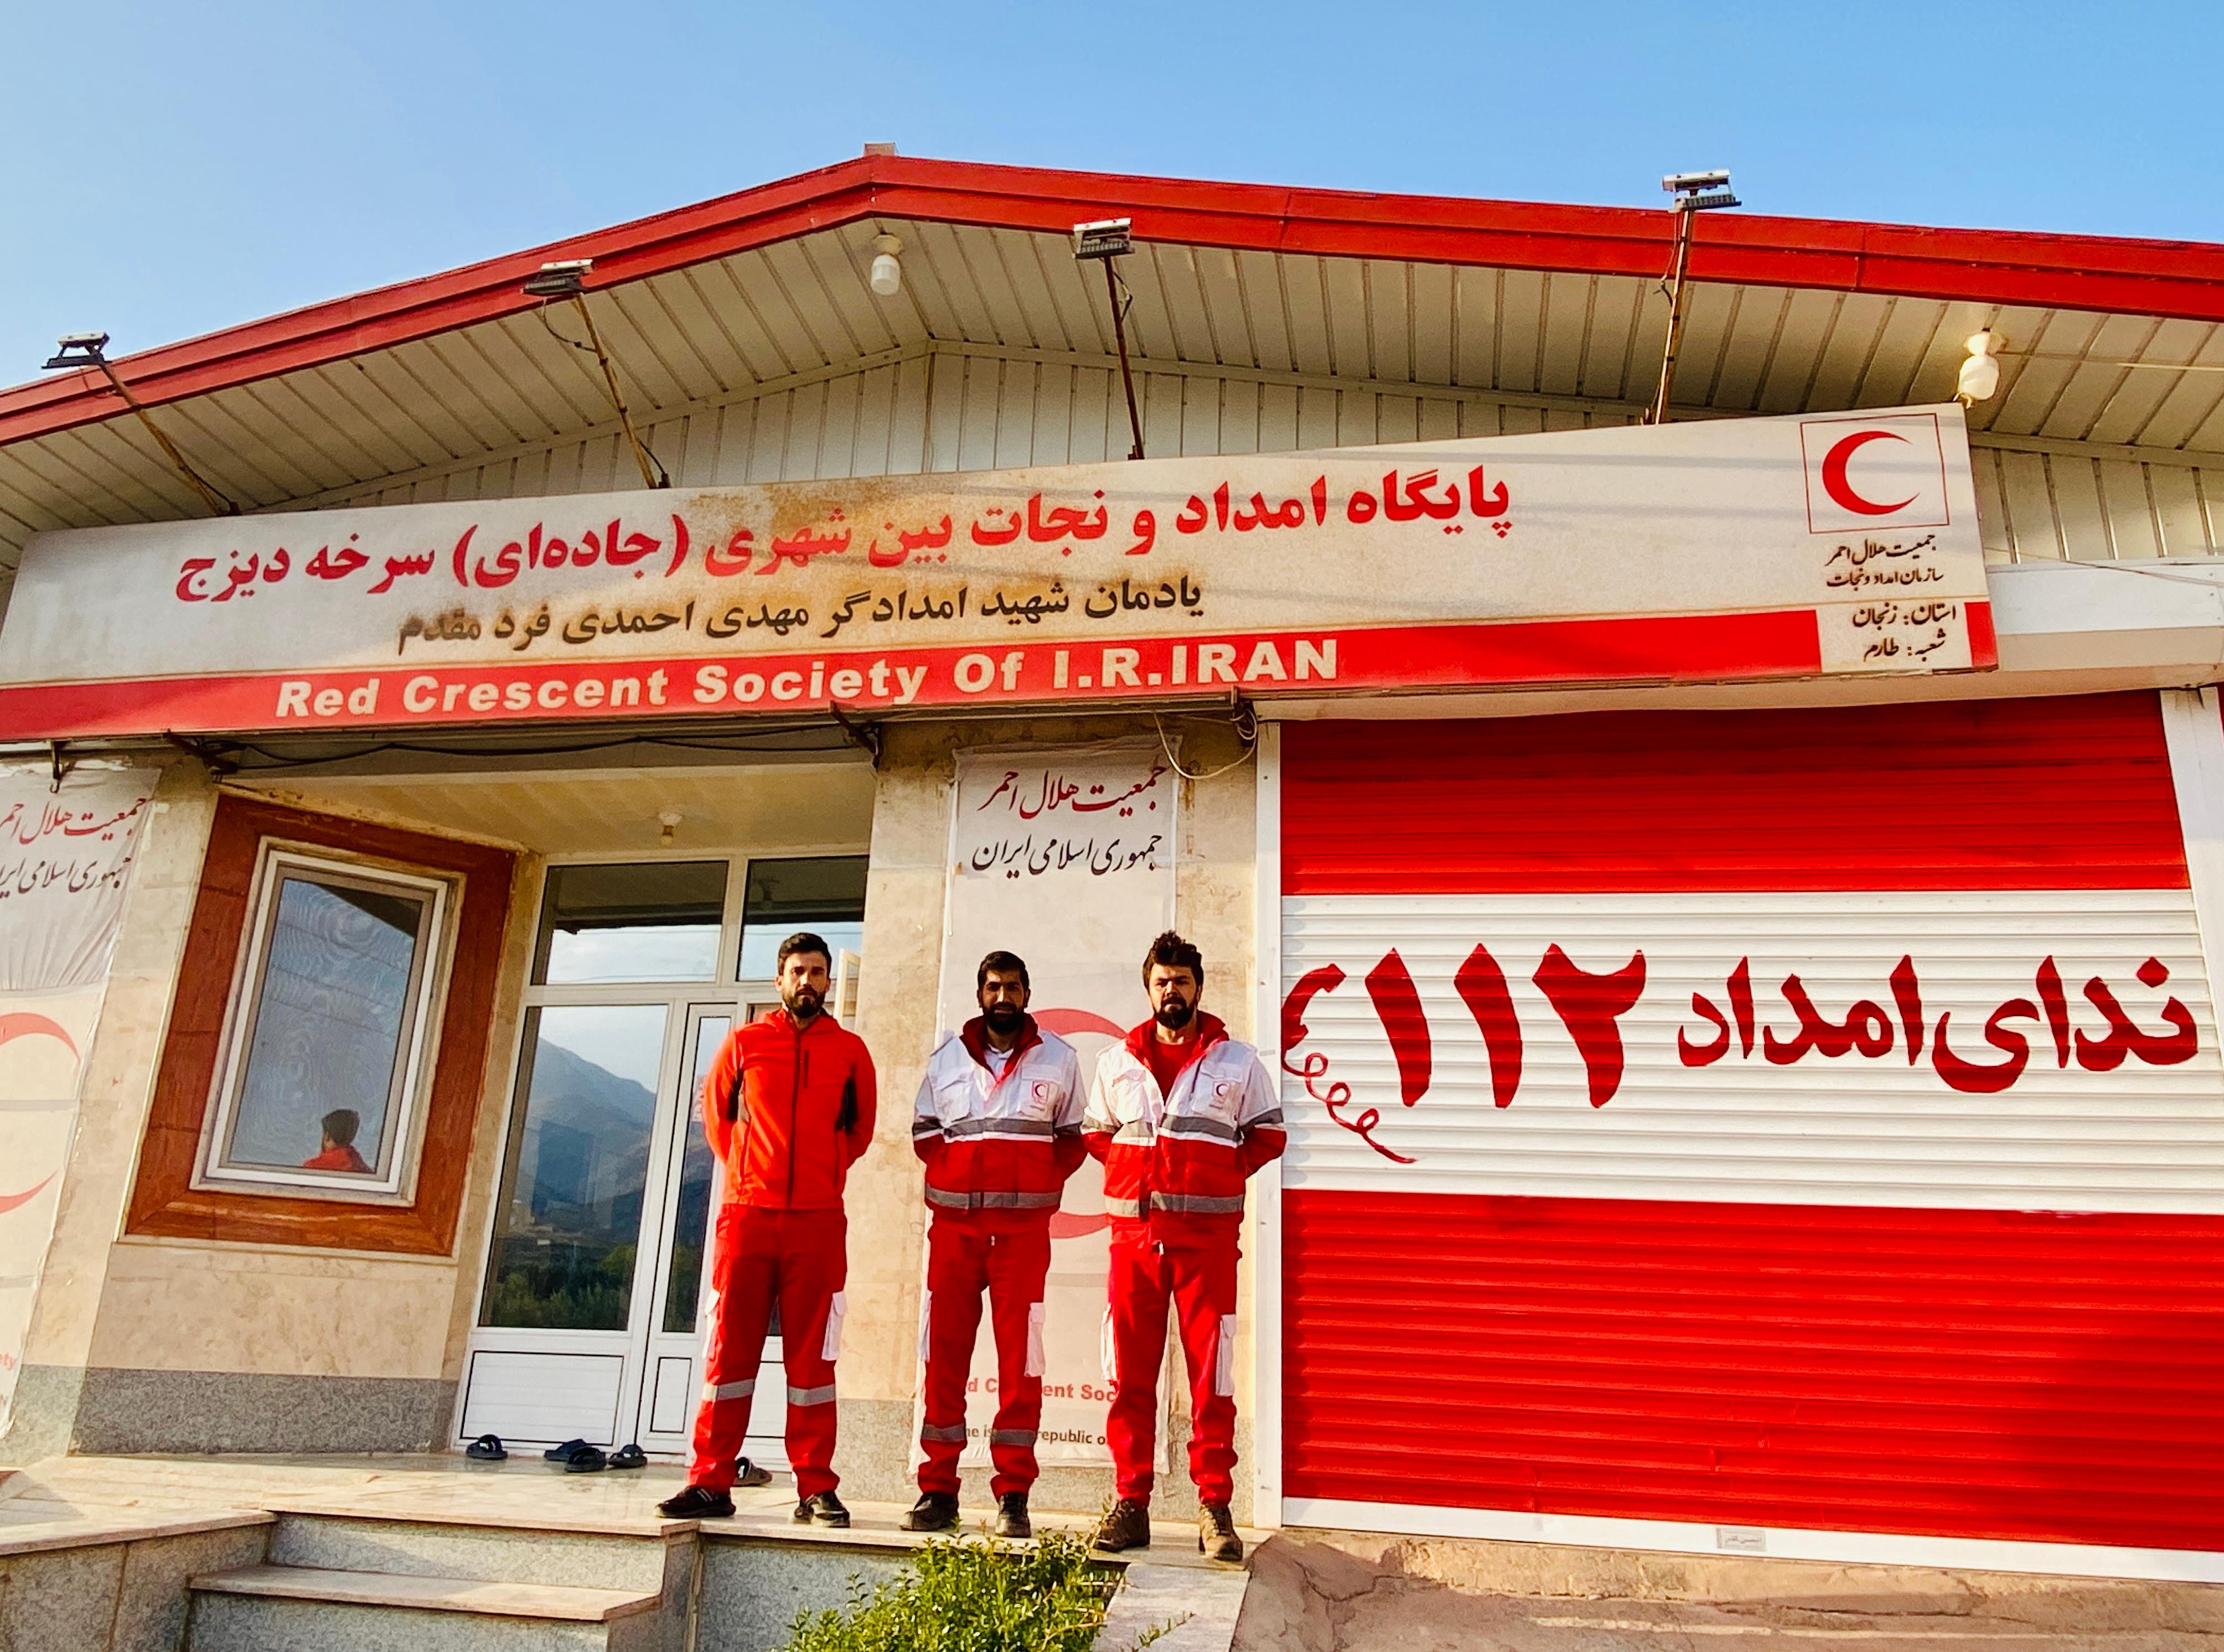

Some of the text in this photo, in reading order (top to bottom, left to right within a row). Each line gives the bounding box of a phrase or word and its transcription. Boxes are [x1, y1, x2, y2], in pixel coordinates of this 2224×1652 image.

[971, 490, 1108, 557] نجات
[1176, 475, 1327, 534] امداد
[1347, 465, 1512, 538] پایگاه
[705, 507, 851, 577] شهری
[868, 515, 953, 568] بین
[1125, 510, 1156, 555] و
[1824, 535, 1936, 567] جمعیت هلال احمر
[175, 547, 290, 602] دیزج
[305, 532, 435, 594] سرخه
[1873, 571, 1899, 585] امداد
[1900, 568, 1944, 585] سازمان
[981, 581, 1069, 625] شهید
[1085, 575, 1204, 619] یادمان
[1853, 602, 1898, 630] زنجان
[398, 607, 482, 656] مقدم
[494, 603, 551, 651] فرد
[562, 600, 695, 645] احمدی
[706, 603, 809, 639] مهدی
[1863, 637, 1899, 662] طارم
[276, 639, 1337, 717] Red Crescent Society Of I.R.IRAN
[976, 767, 1167, 820] جمعیت هلال احمر
[19, 801, 73, 844] هلال
[64, 797, 146, 841] جمعیت
[18, 859, 76, 894] اسلامی
[69, 857, 131, 893] جهوری
[972, 834, 1162, 879] جمهوری اسلامی ایران
[1365, 943, 2199, 1109] ندای امداد ۱۱۲
